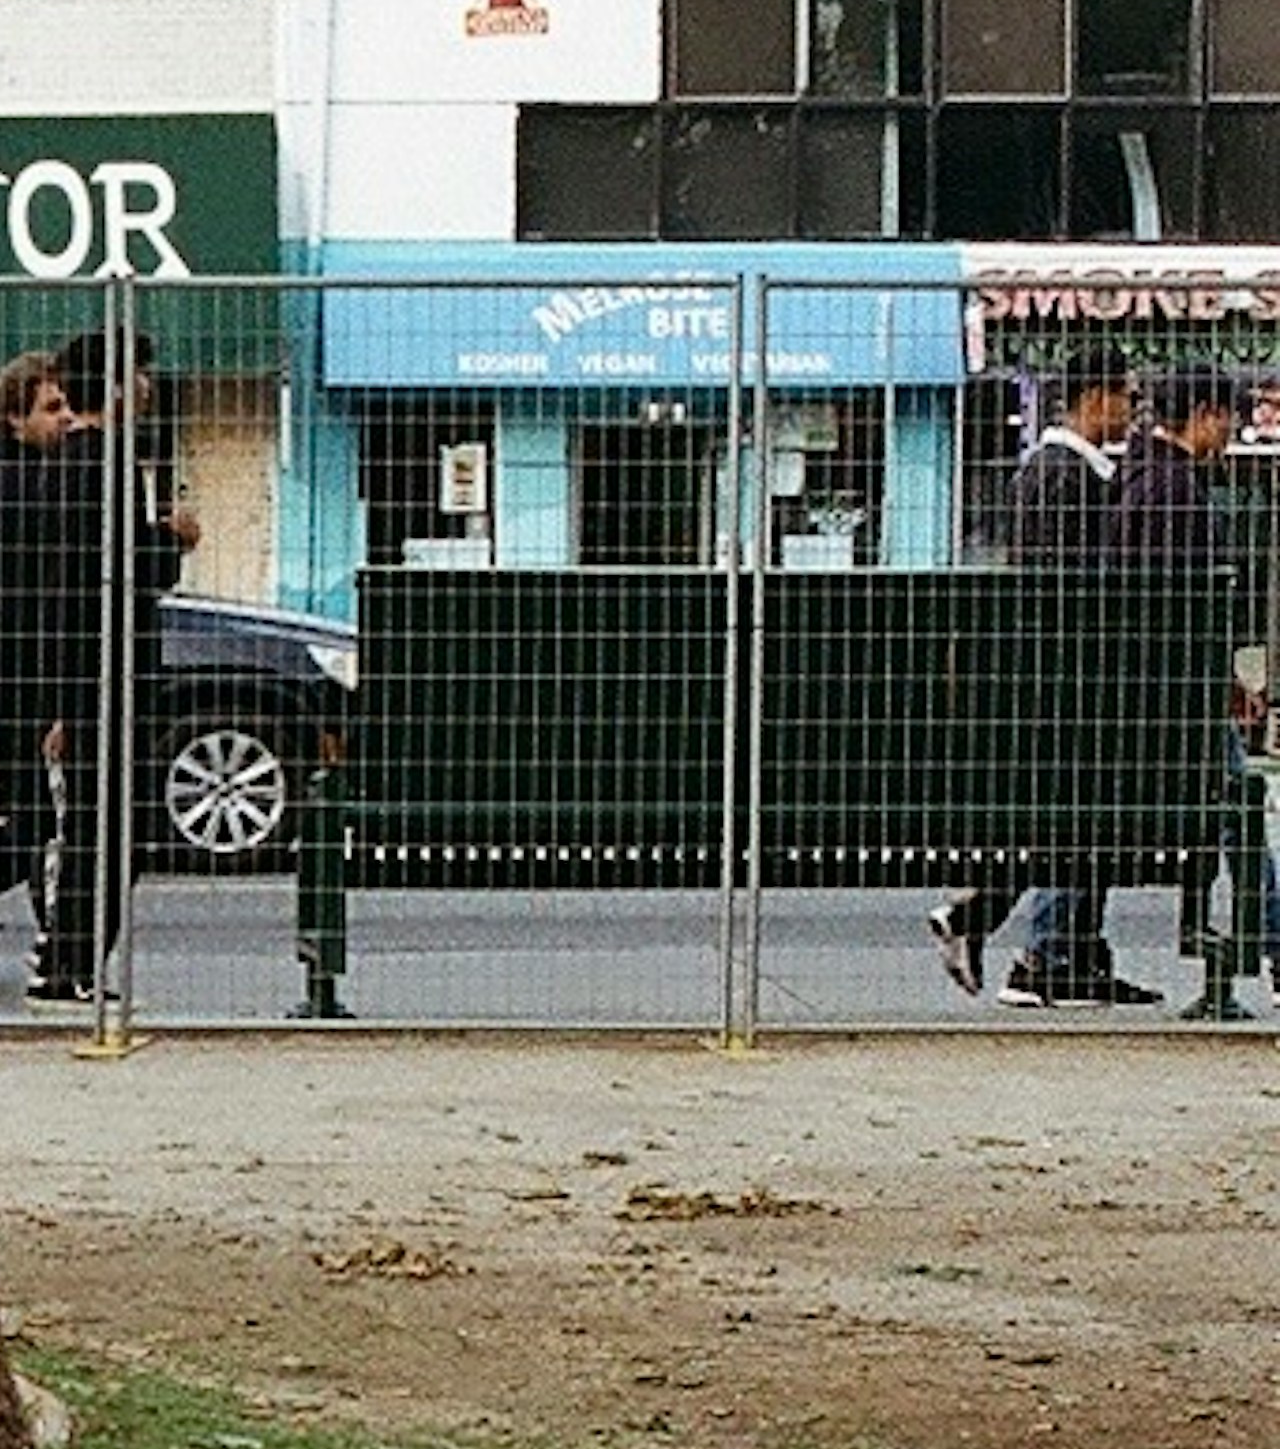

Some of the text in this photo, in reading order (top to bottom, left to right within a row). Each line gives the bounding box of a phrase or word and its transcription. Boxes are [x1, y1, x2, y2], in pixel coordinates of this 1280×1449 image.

[532, 269, 712, 343] MELROSE
[976, 269, 1226, 320] SMOKE
[647, 307, 729, 339] BITE
[457, 352, 549, 375] KOSHER
[577, 352, 656, 375] VEGAN
